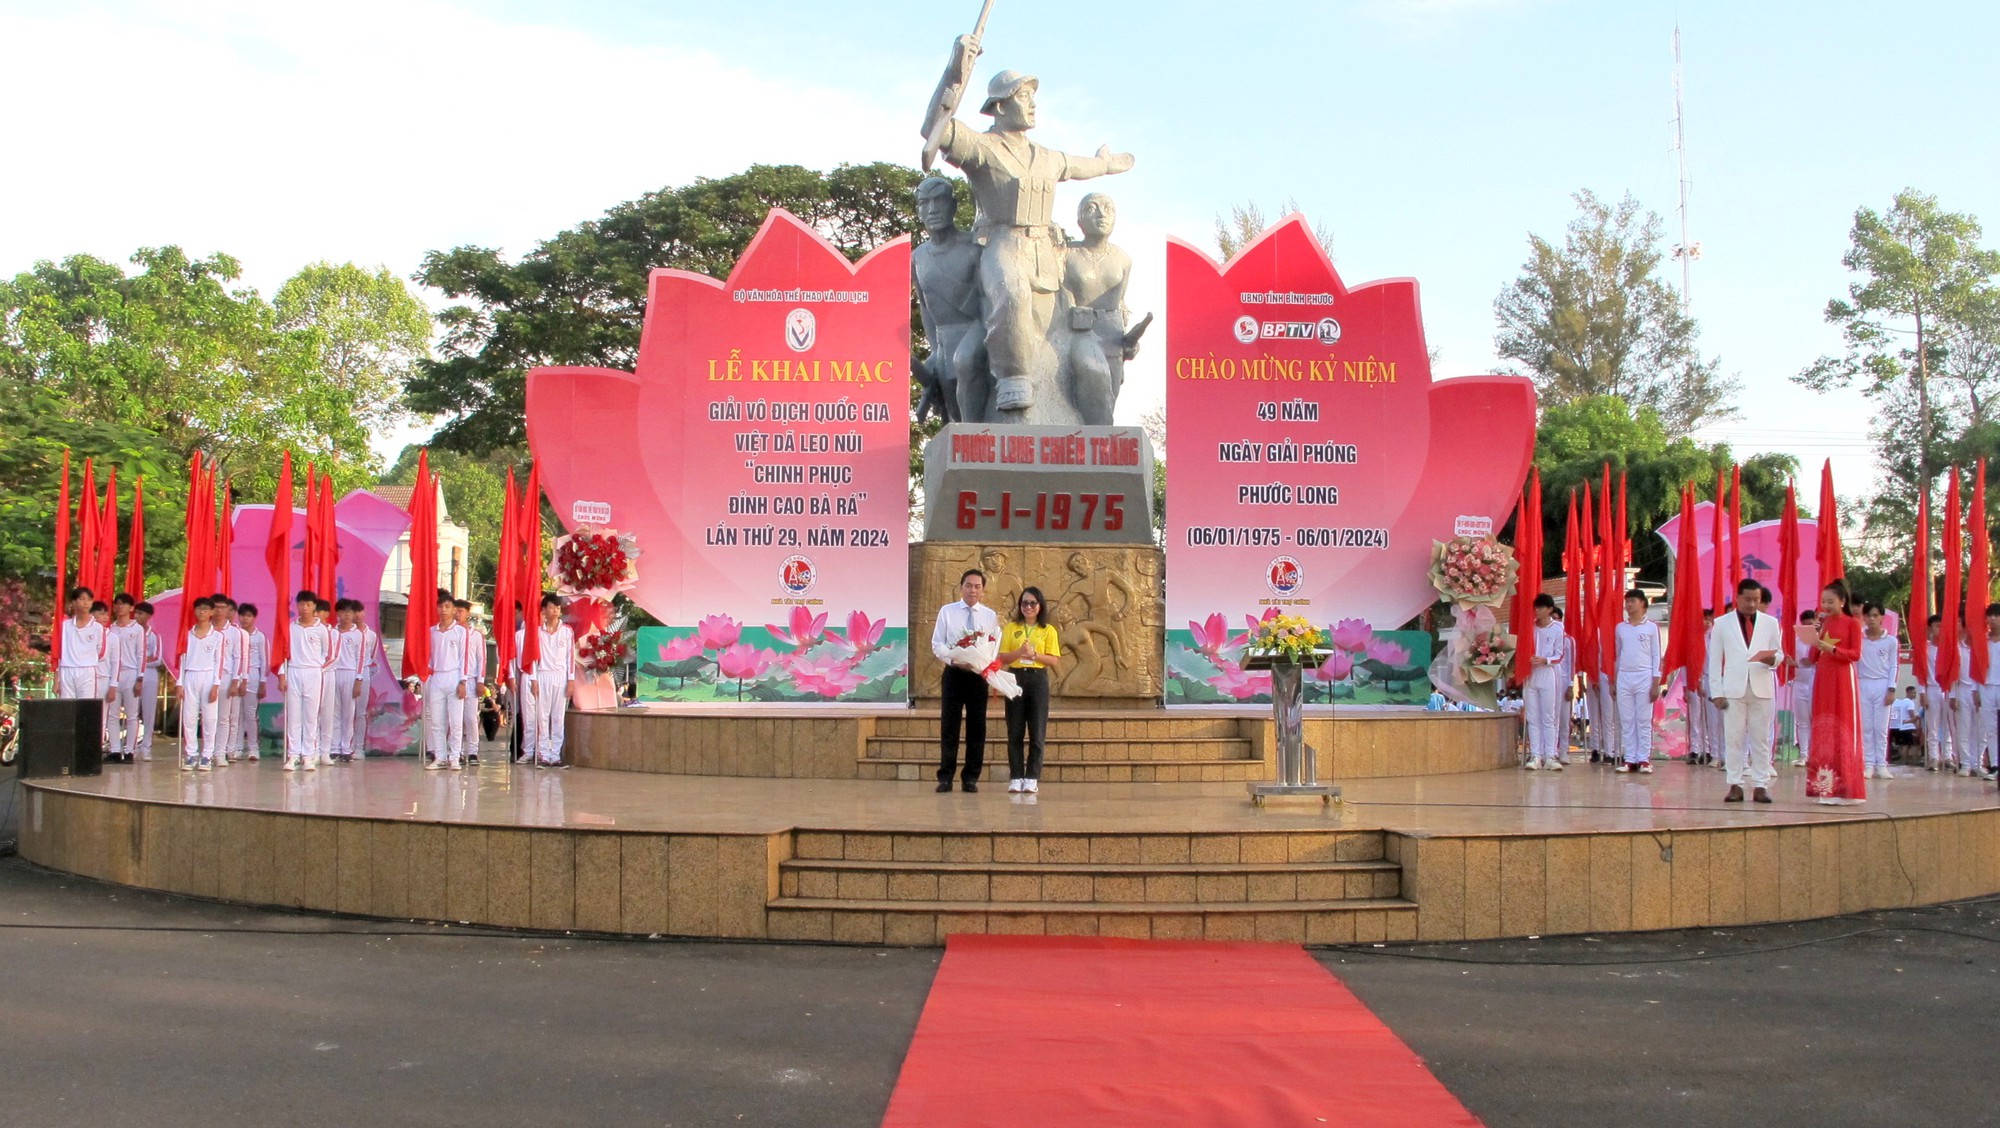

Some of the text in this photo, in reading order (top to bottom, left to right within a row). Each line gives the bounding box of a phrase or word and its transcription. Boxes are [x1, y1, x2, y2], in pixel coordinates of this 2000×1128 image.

[734, 289, 746, 303] BỘ
[747, 289, 764, 301] VĂN
[765, 289, 782, 301] HÓA
[802, 291, 822, 302] THAO
[824, 289, 835, 302] VÀ
[836, 291, 848, 302] DU
[849, 291, 868, 304] LỊCH
[1241, 292, 1263, 304] UBND
[1262, 323, 1314, 338] BPTV
[707, 349, 893, 388] LỄ KHAI MẠC
[1176, 352, 1396, 388] CHÀO MỪNG KỶ NIỆM
[709, 397, 889, 425] GIẢI VÔ ĐỊCH QUỐC GIA
[1257, 398, 1318, 421] 49 NĂM
[735, 430, 863, 456] VIỆT DÃ LEO NÚI
[952, 428, 1139, 466] PHƯỚC LONG CHIẾN THẮNG
[1218, 438, 1357, 463] NGÀY GIẢI PHÓNG
[809, 465, 852, 488] PHỤC
[729, 491, 867, 515] ĐỈNH CAO BÀ RÁ”
[1238, 483, 1338, 505] PHƯỚC LONG
[957, 490, 1126, 531] 6-1-1975
[706, 520, 889, 549] LẦN THỨ 29, NĂM 2024
[1187, 527, 1281, 547] (06/01/1975
[1296, 529, 1389, 549] 06/01/2024)
